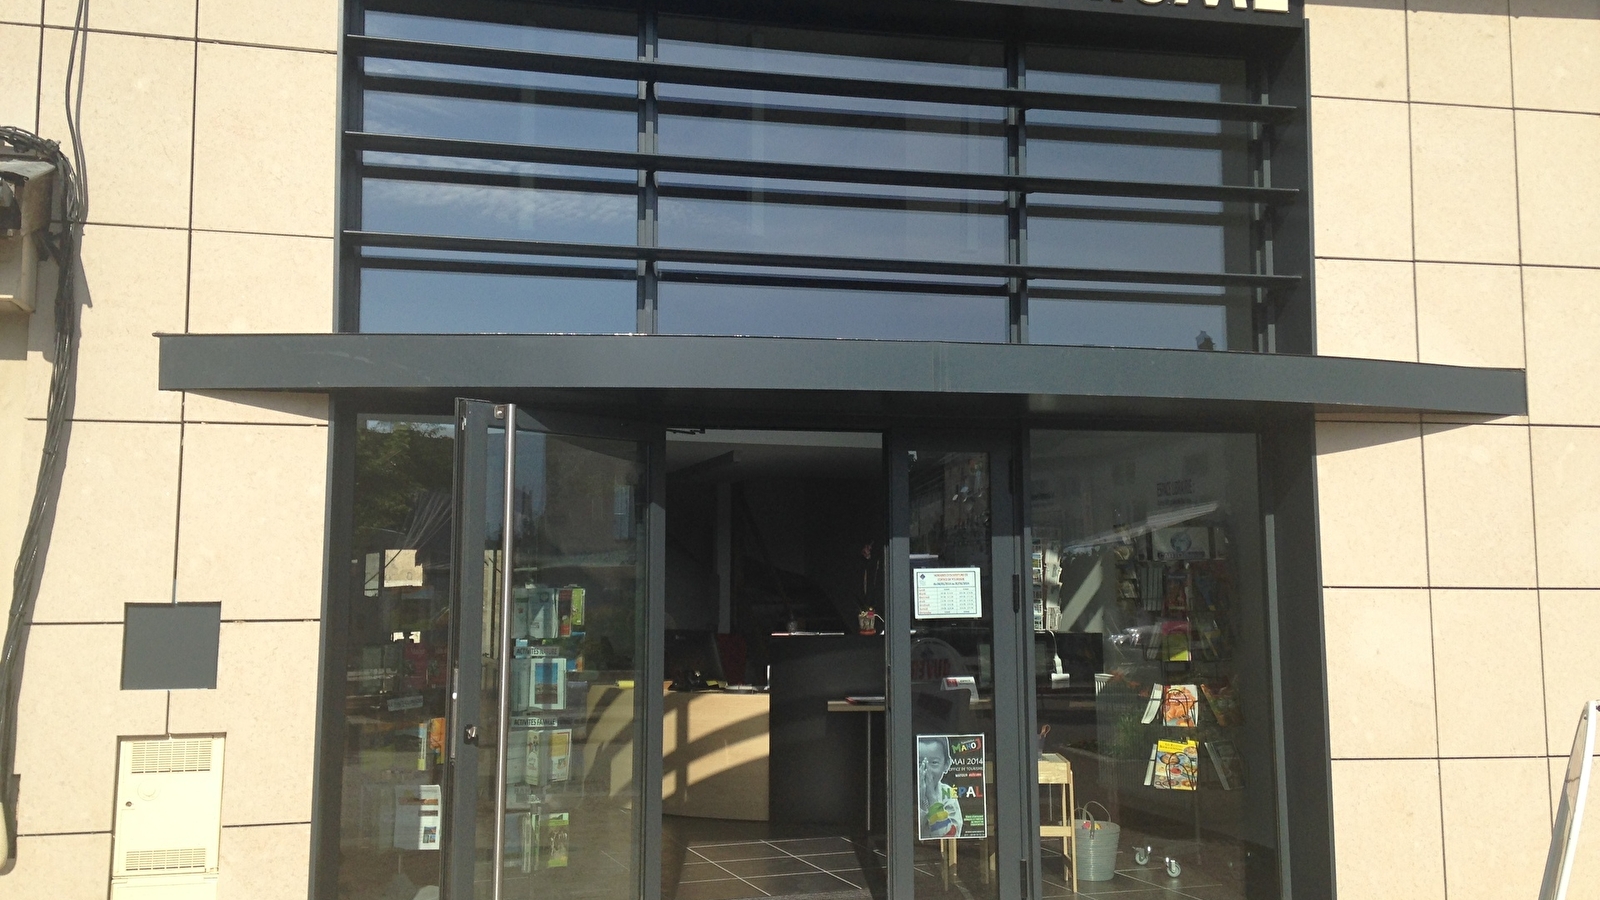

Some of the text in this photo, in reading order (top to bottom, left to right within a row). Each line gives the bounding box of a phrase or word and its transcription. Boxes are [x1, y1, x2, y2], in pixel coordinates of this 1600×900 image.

[514, 718, 536, 726] ACTIVITES
[951, 757, 983, 766] MAI 2014
[942, 784, 983, 799] NÉPAL
